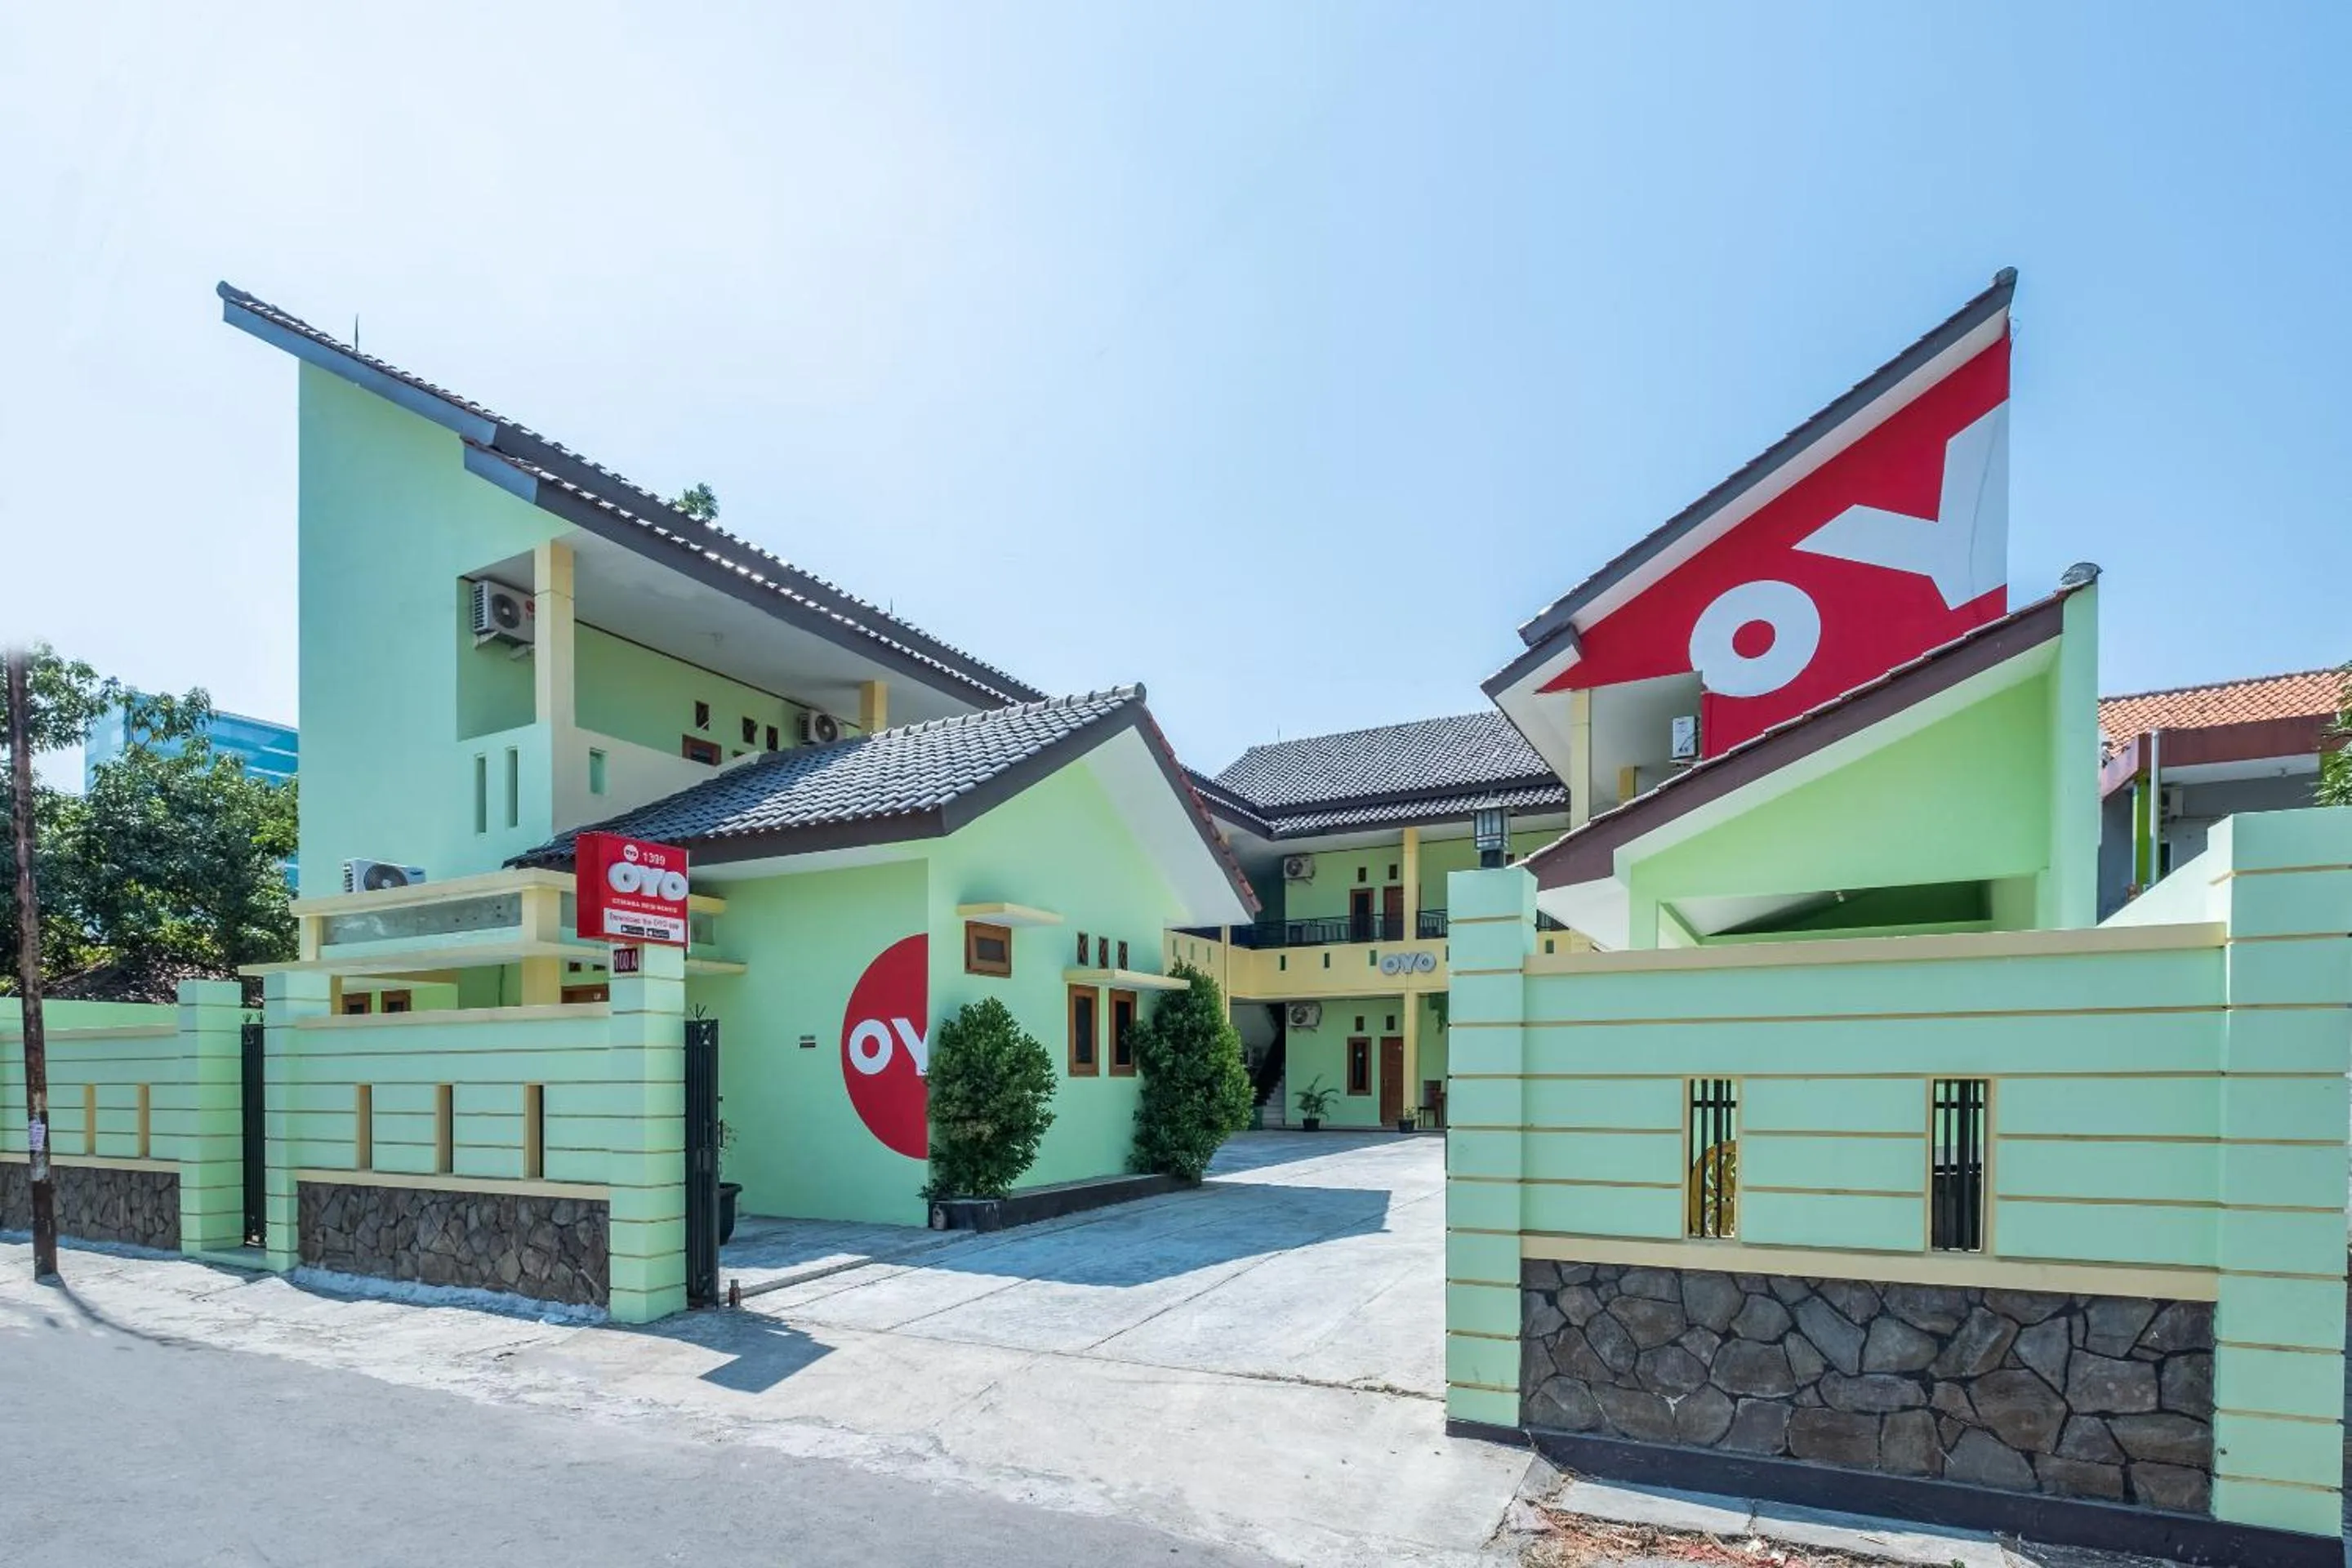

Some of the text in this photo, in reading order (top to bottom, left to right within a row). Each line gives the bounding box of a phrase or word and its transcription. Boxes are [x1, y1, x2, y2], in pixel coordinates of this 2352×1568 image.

[643, 852, 666, 866] 1399
[608, 862, 688, 901] OYO
[1380, 951, 1437, 976] OYO
